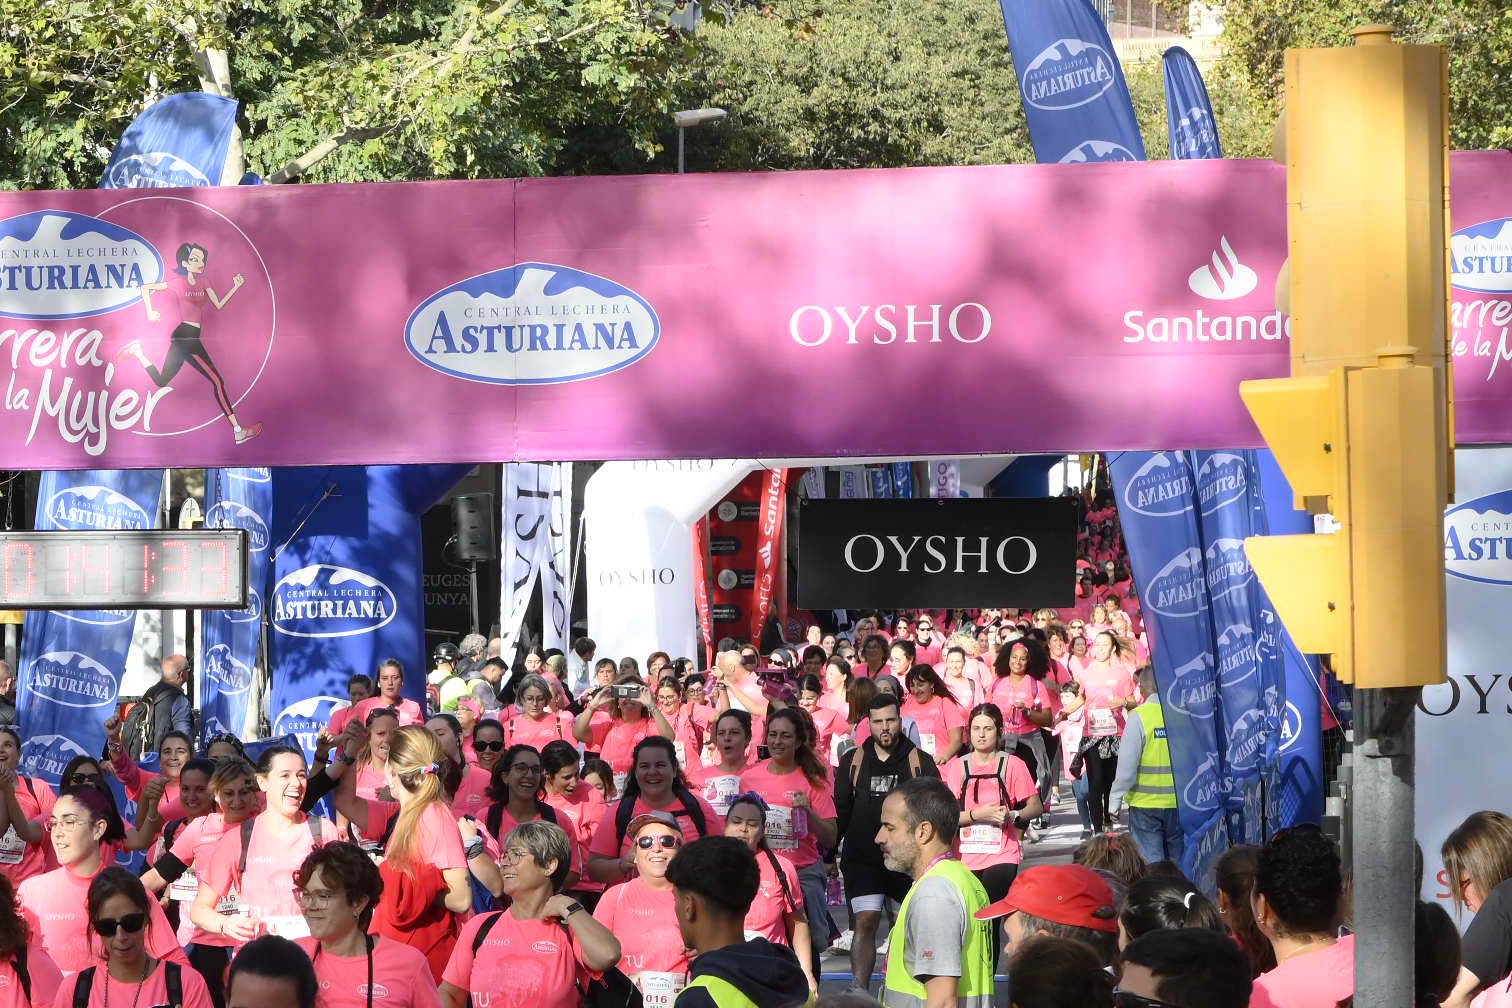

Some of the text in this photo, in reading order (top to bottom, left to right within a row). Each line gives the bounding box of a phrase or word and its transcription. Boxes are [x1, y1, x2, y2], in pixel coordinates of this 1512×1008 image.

[67, 246, 138, 258] LECHERA
[464, 303, 632, 318] CENTRAL LECHERA
[424, 310, 640, 355] ASTURIANA
[789, 302, 992, 347] OYSHO
[6, 370, 30, 411] la
[25, 362, 174, 457] Mujer
[844, 534, 1038, 575] OYSHO
[599, 567, 675, 585] OYSHO
[287, 589, 382, 599] CENTRAL LECHERA
[275, 594, 388, 622] ASTURIANA
[30, 666, 110, 700] ASTURIANA
[473, 991, 490, 1008] TU
[646, 995, 668, 1004] 016
